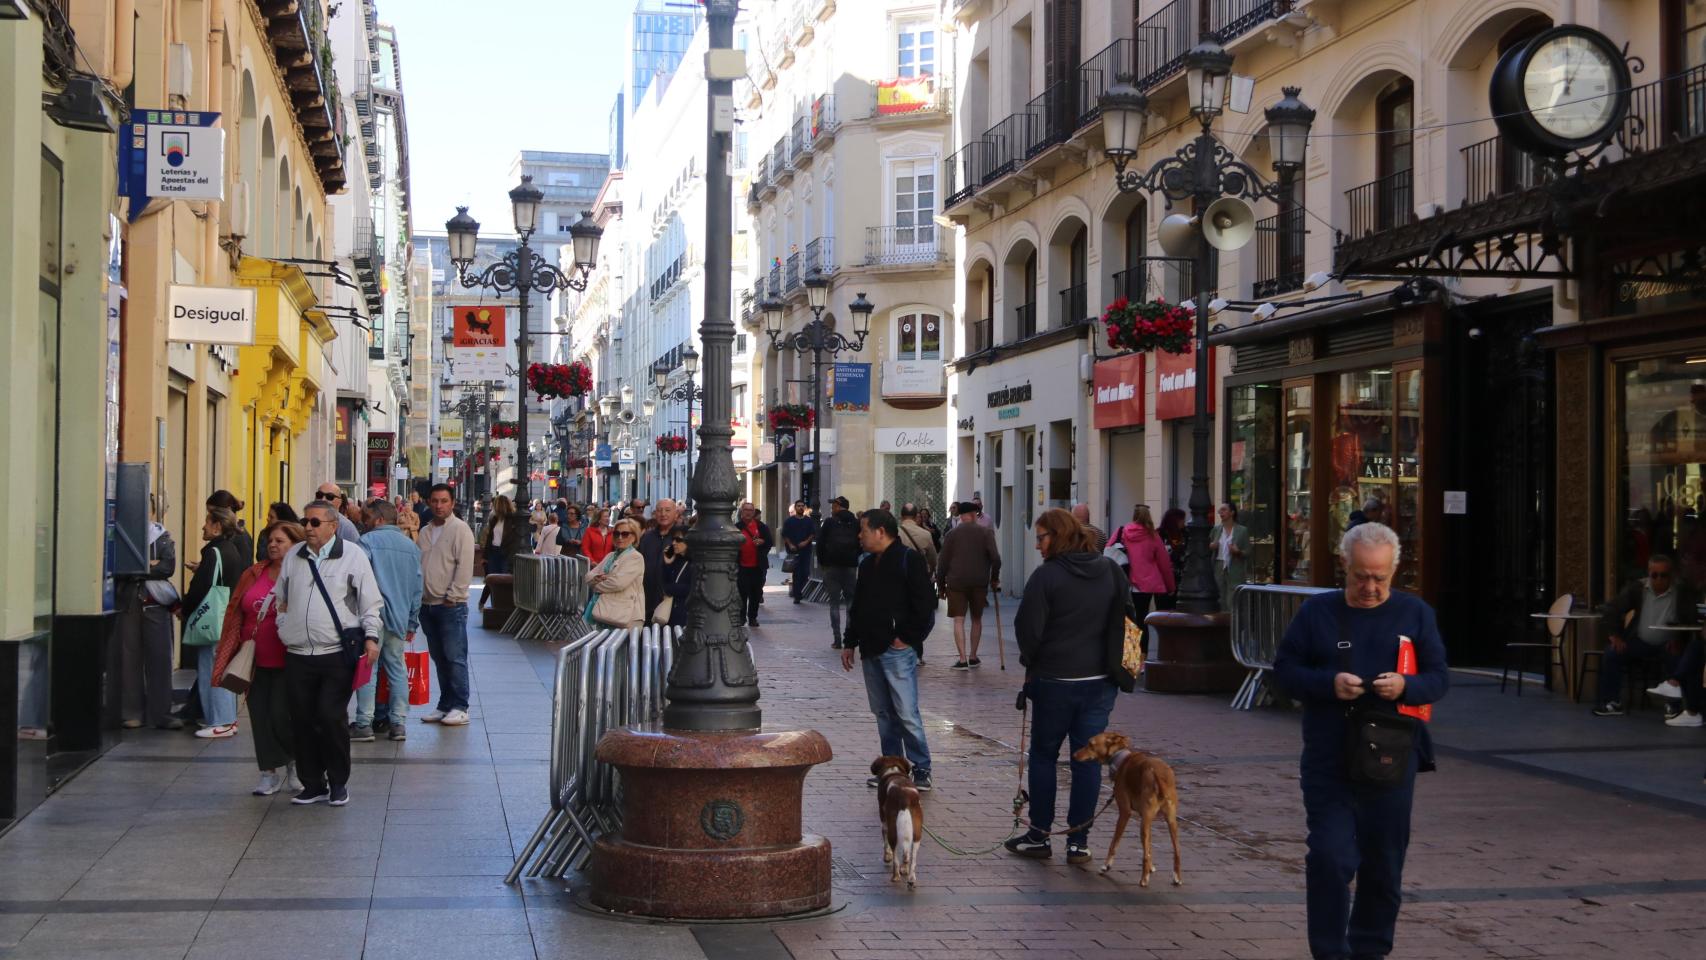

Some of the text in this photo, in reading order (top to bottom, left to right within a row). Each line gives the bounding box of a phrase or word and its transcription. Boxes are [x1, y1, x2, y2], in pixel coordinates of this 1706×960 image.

[161, 168, 191, 176] Loterías
[174, 305, 249, 324] Desigual.
[1184, 368, 1196, 388] Ma
[1097, 386, 1110, 404] Foot
